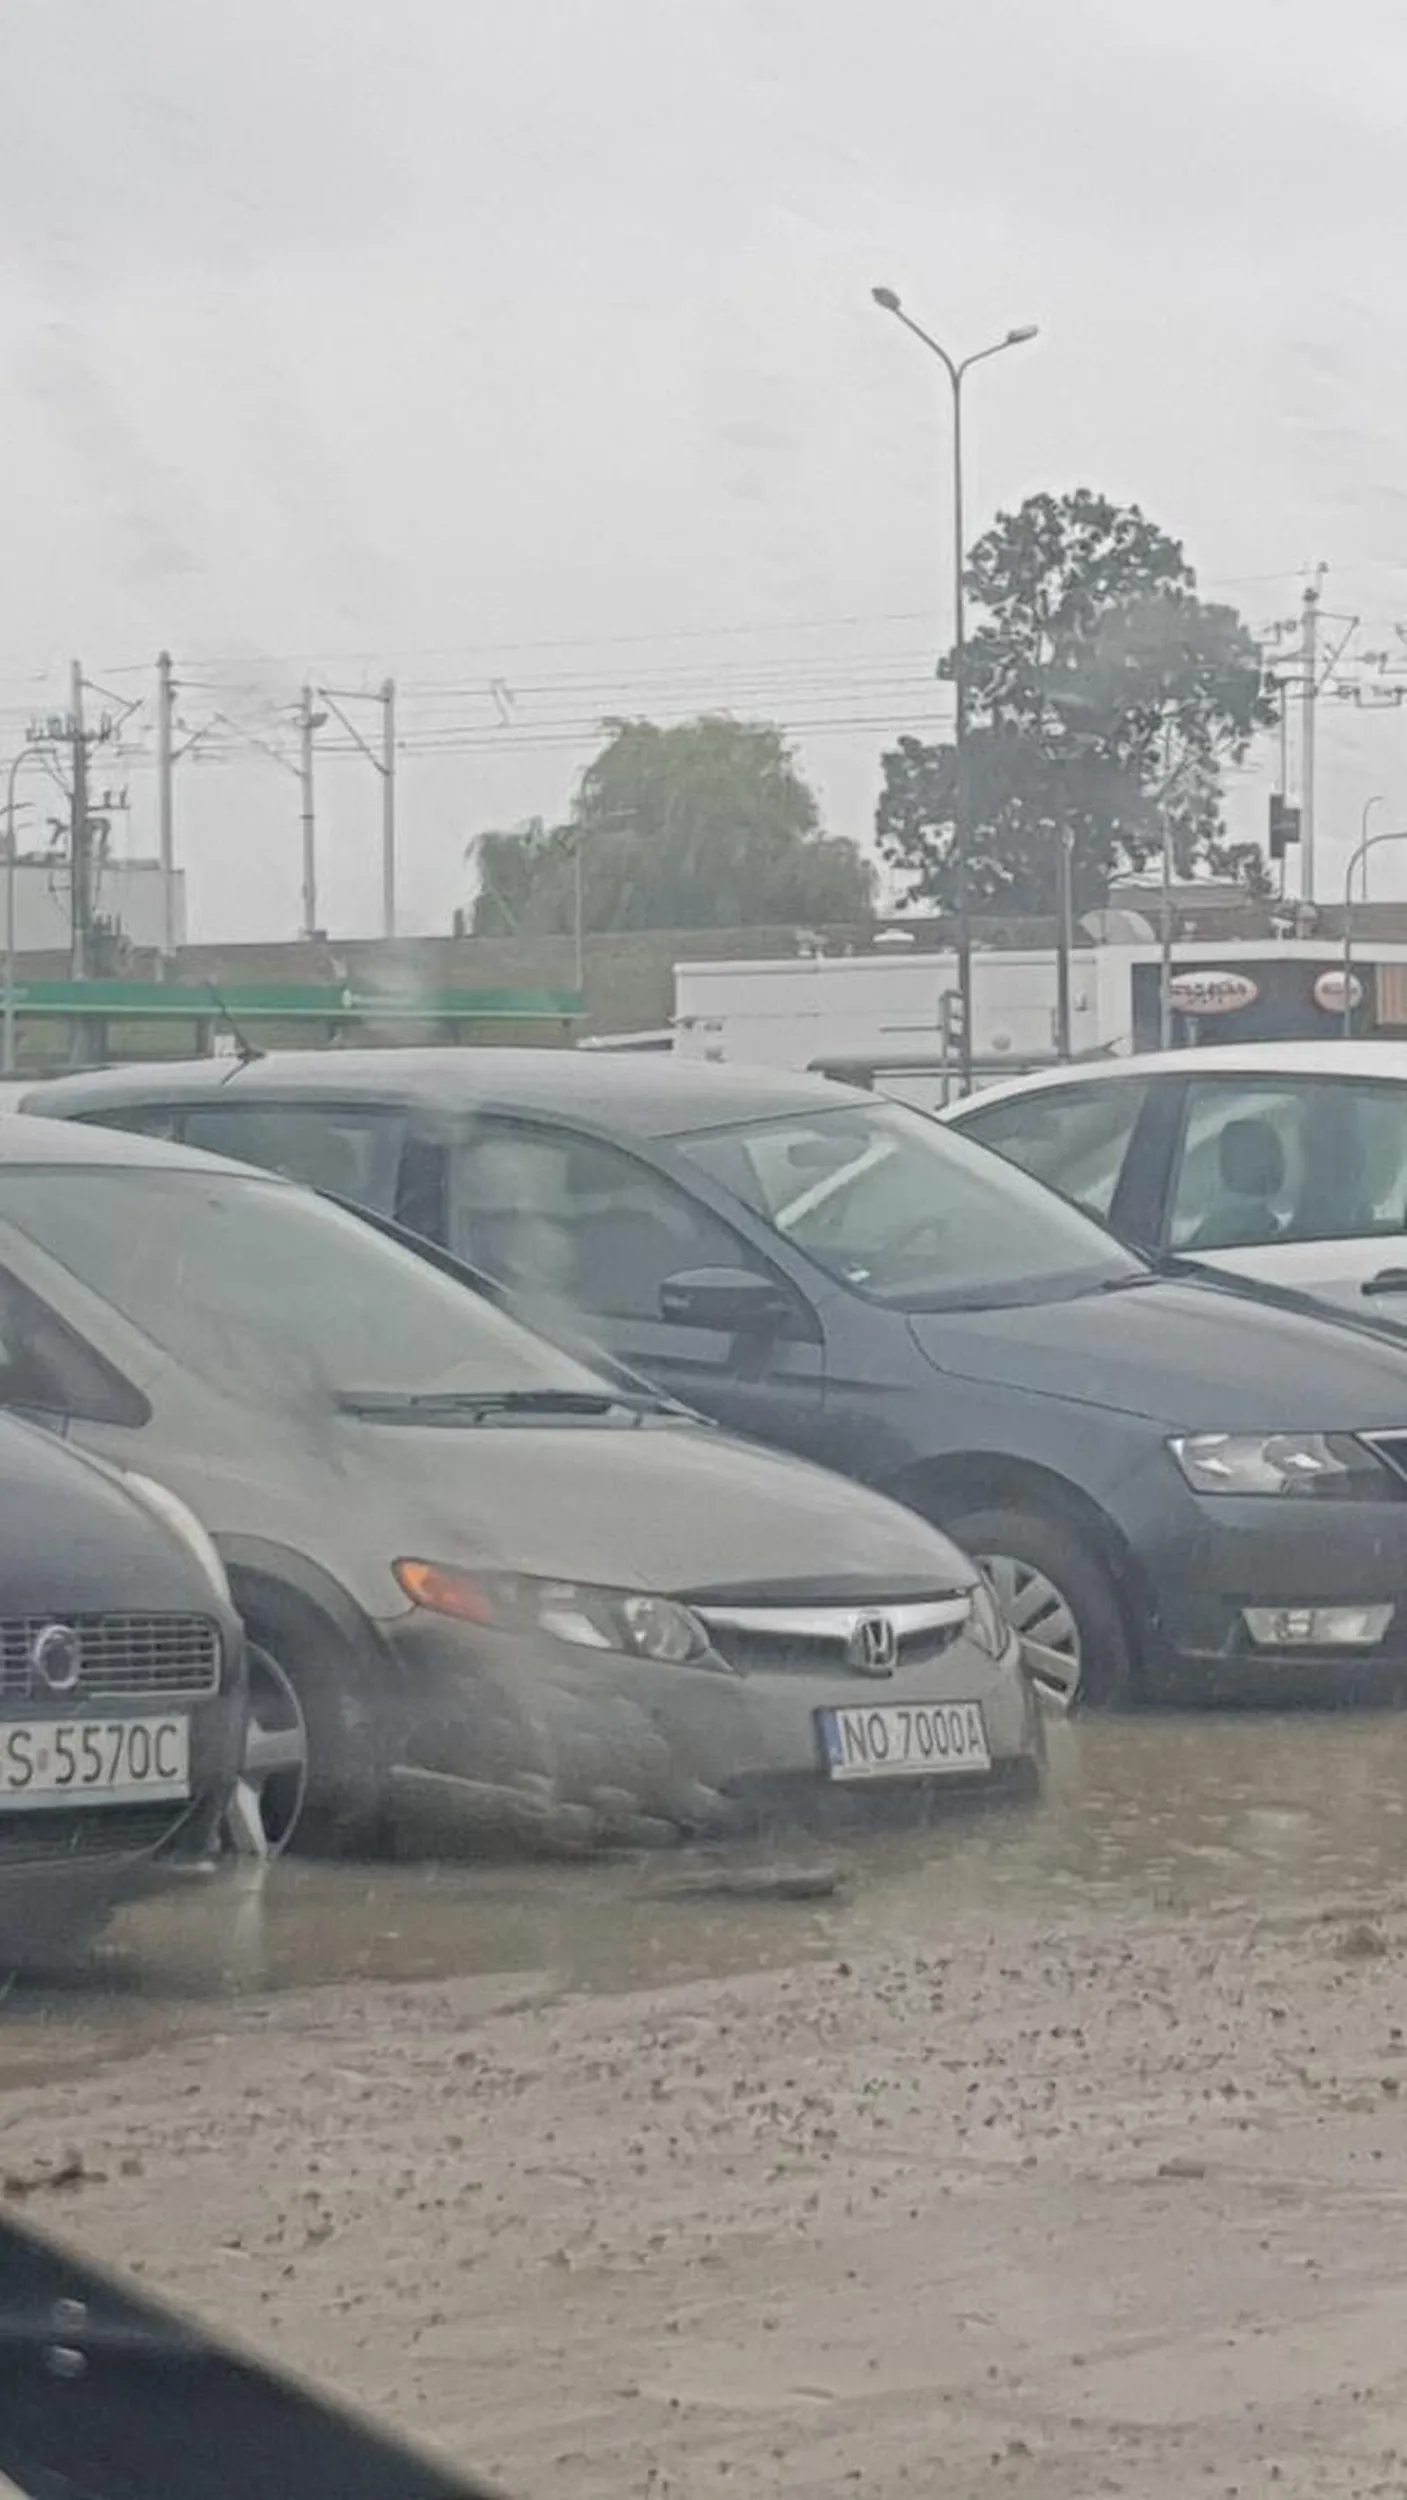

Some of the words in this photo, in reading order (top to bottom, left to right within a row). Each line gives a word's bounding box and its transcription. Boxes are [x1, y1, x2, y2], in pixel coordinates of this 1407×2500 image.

[54, 1723, 178, 1785] 5570C
[843, 1711, 890, 1760] NO
[897, 1710, 983, 1758] 7000A
